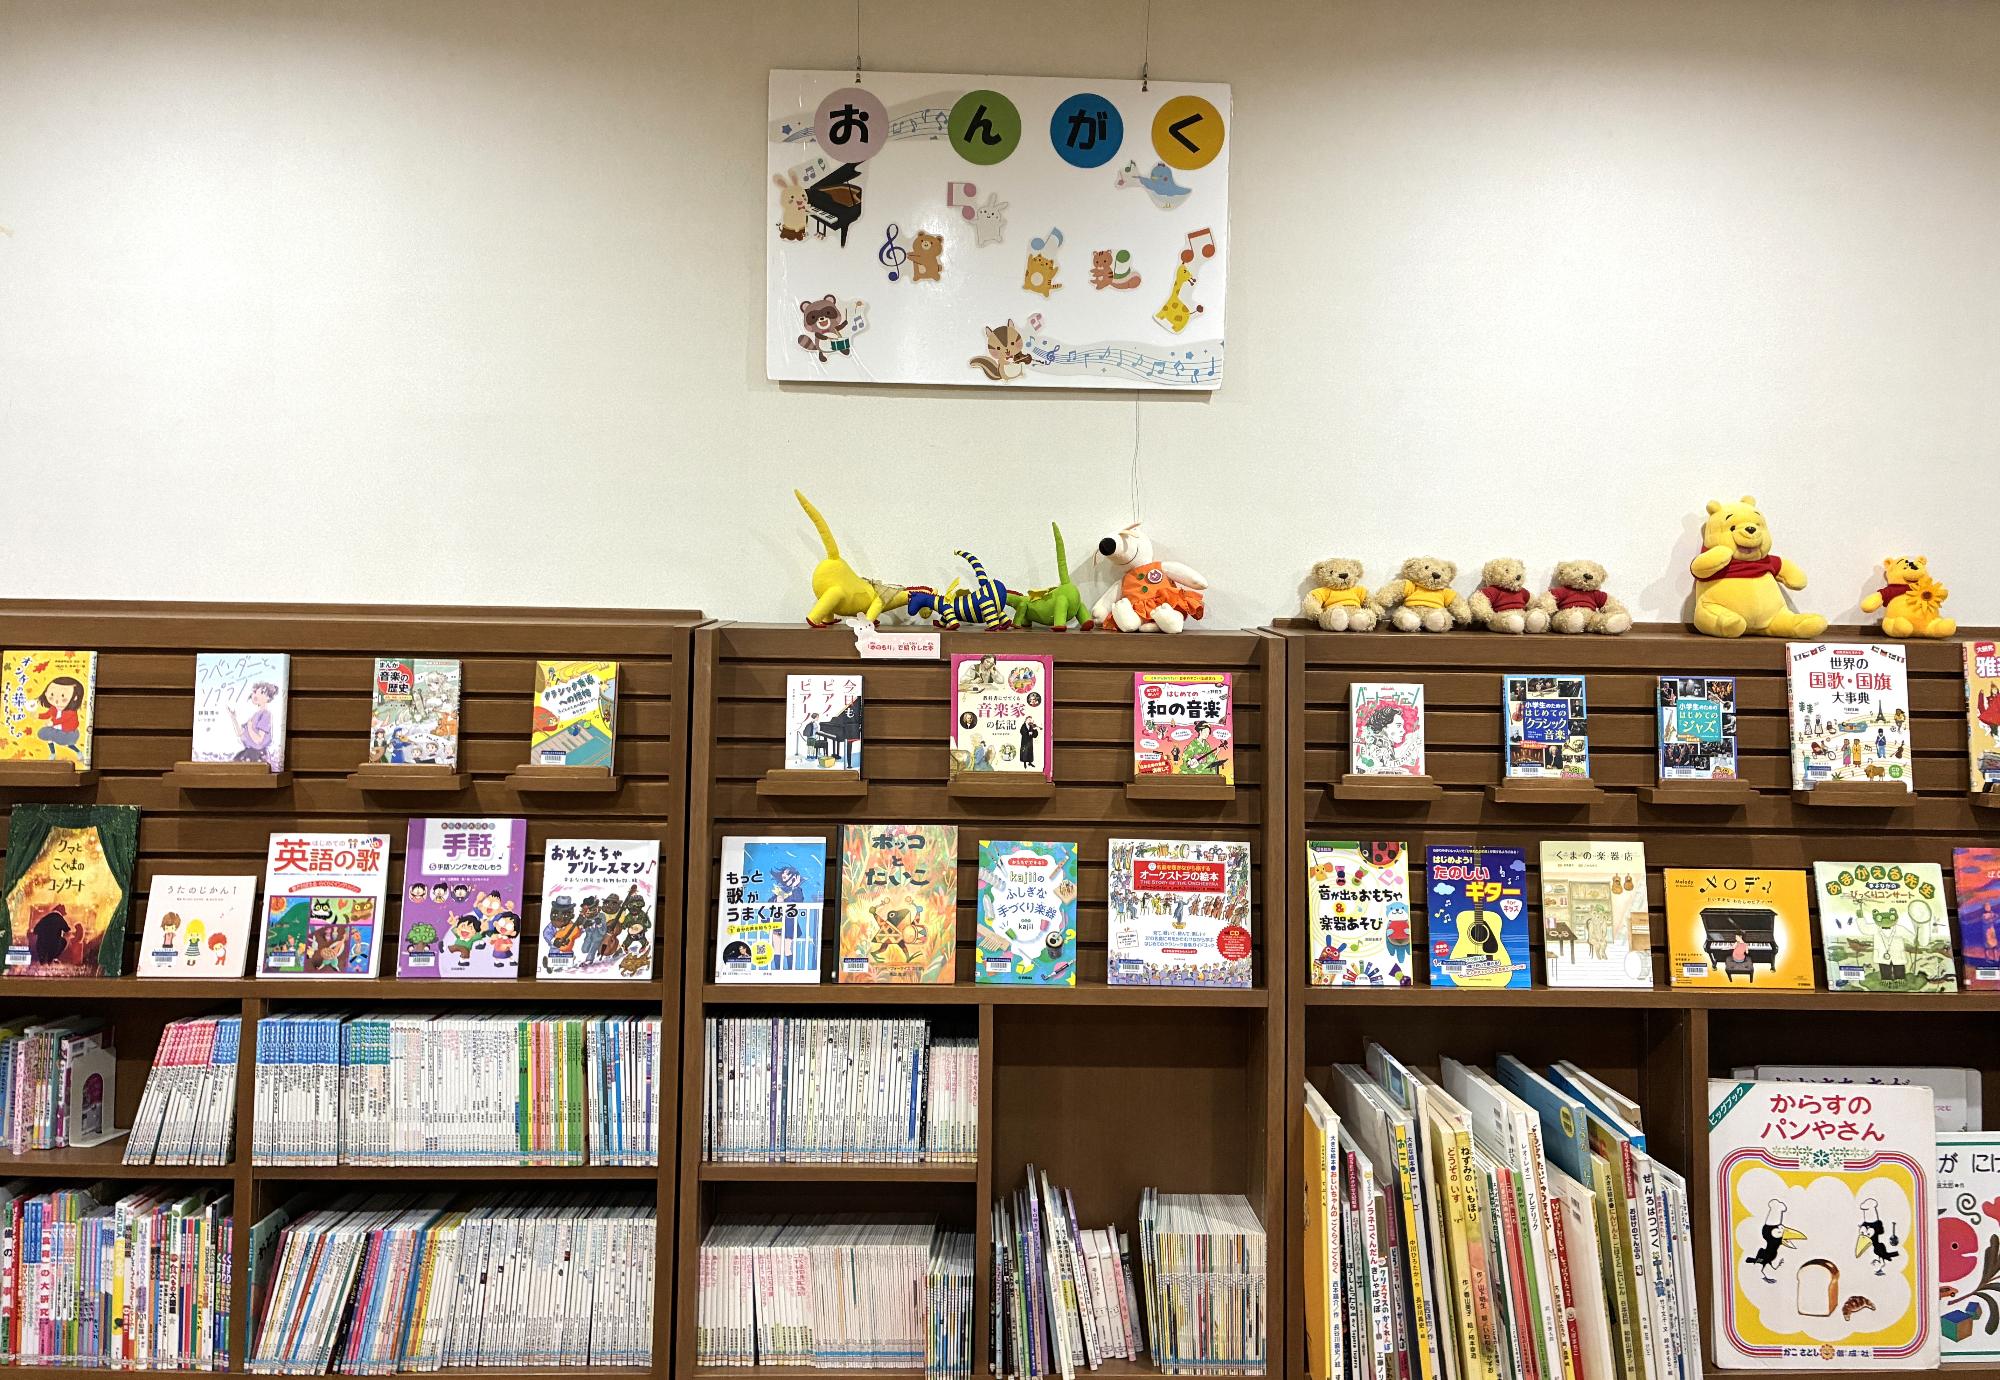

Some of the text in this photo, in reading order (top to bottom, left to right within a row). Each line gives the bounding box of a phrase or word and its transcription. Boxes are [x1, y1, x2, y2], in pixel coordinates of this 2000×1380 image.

[829, 103, 1204, 154] おんがく
[1830, 656, 1869, 670] 世界の
[380, 671, 409, 682] 音楽の
[1809, 672, 1893, 690] 国歌・国旗
[388, 683, 410, 694] 歴史
[844, 679, 857, 719] 今日も
[1525, 701, 1566, 709] 小学生のための
[1831, 691, 1870, 704] 大事典
[977, 703, 1026, 718] 音楽家
[1147, 700, 1221, 719] 和の音楽
[1525, 709, 1567, 717] はじめての
[1679, 703, 1718, 711] 小学生のための
[986, 720, 1017, 731] の伝記
[58, 840, 83, 853] クマと
[442, 833, 493, 858] 手話
[872, 833, 926, 850] ポッコ
[274, 839, 381, 873] 英語の歌
[551, 845, 623, 861] おれたちゃ
[892, 855, 905, 867] と
[1432, 856, 1473, 864] はじめよう!
[1556, 851, 1633, 862] くまの楽器店
[53, 857, 85, 873] こぐまの
[438, 863, 503, 871] 手話ソングをたのしもう
[567, 862, 646, 875] ブルースマン
[1433, 865, 1491, 881] たのしい
[726, 870, 764, 885] もっと
[865, 867, 930, 886] たいこ
[1009, 870, 1046, 885] kajiiの
[1140, 870, 1219, 881] オーケストラの絵本
[1828, 866, 1935, 899] あまがえる先生
[48, 877, 86, 894] コンサート
[1006, 886, 1048, 900] ふしぎな
[1318, 884, 1403, 902] 音が出るおもちゃ
[1465, 881, 1521, 903] ギター
[727, 887, 759, 904] 歌が
[1850, 890, 1914, 900] びっくりコンサート
[727, 903, 806, 922] うまくなる。
[997, 902, 1057, 920] 手づくり楽器
[1335, 902, 1345, 913] &
[1319, 915, 1383, 931] 楽器あそび
[1709, 1085, 1745, 1126] ビッグブック
[1770, 1094, 1872, 1116] からすの
[1760, 1120, 1886, 1143] パンやさん
[1938, 1152, 1958, 1174] が
[1460, 1147, 1478, 1222] ねずみの いもほり
[1528, 1193, 1539, 1231] フレデリック
[1643, 1174, 1660, 1248] せんろはつづく
[1367, 1200, 1378, 1265] ノラネコぐんだん
[1629, 1208, 1641, 1260] おばけのてんぷら
[1380, 1269, 1391, 1351] クリスマスのかくれんぼ
[1783, 1348, 1819, 1357] かこ さとし
[1836, 1349, 1870, 1358] 偕成社
